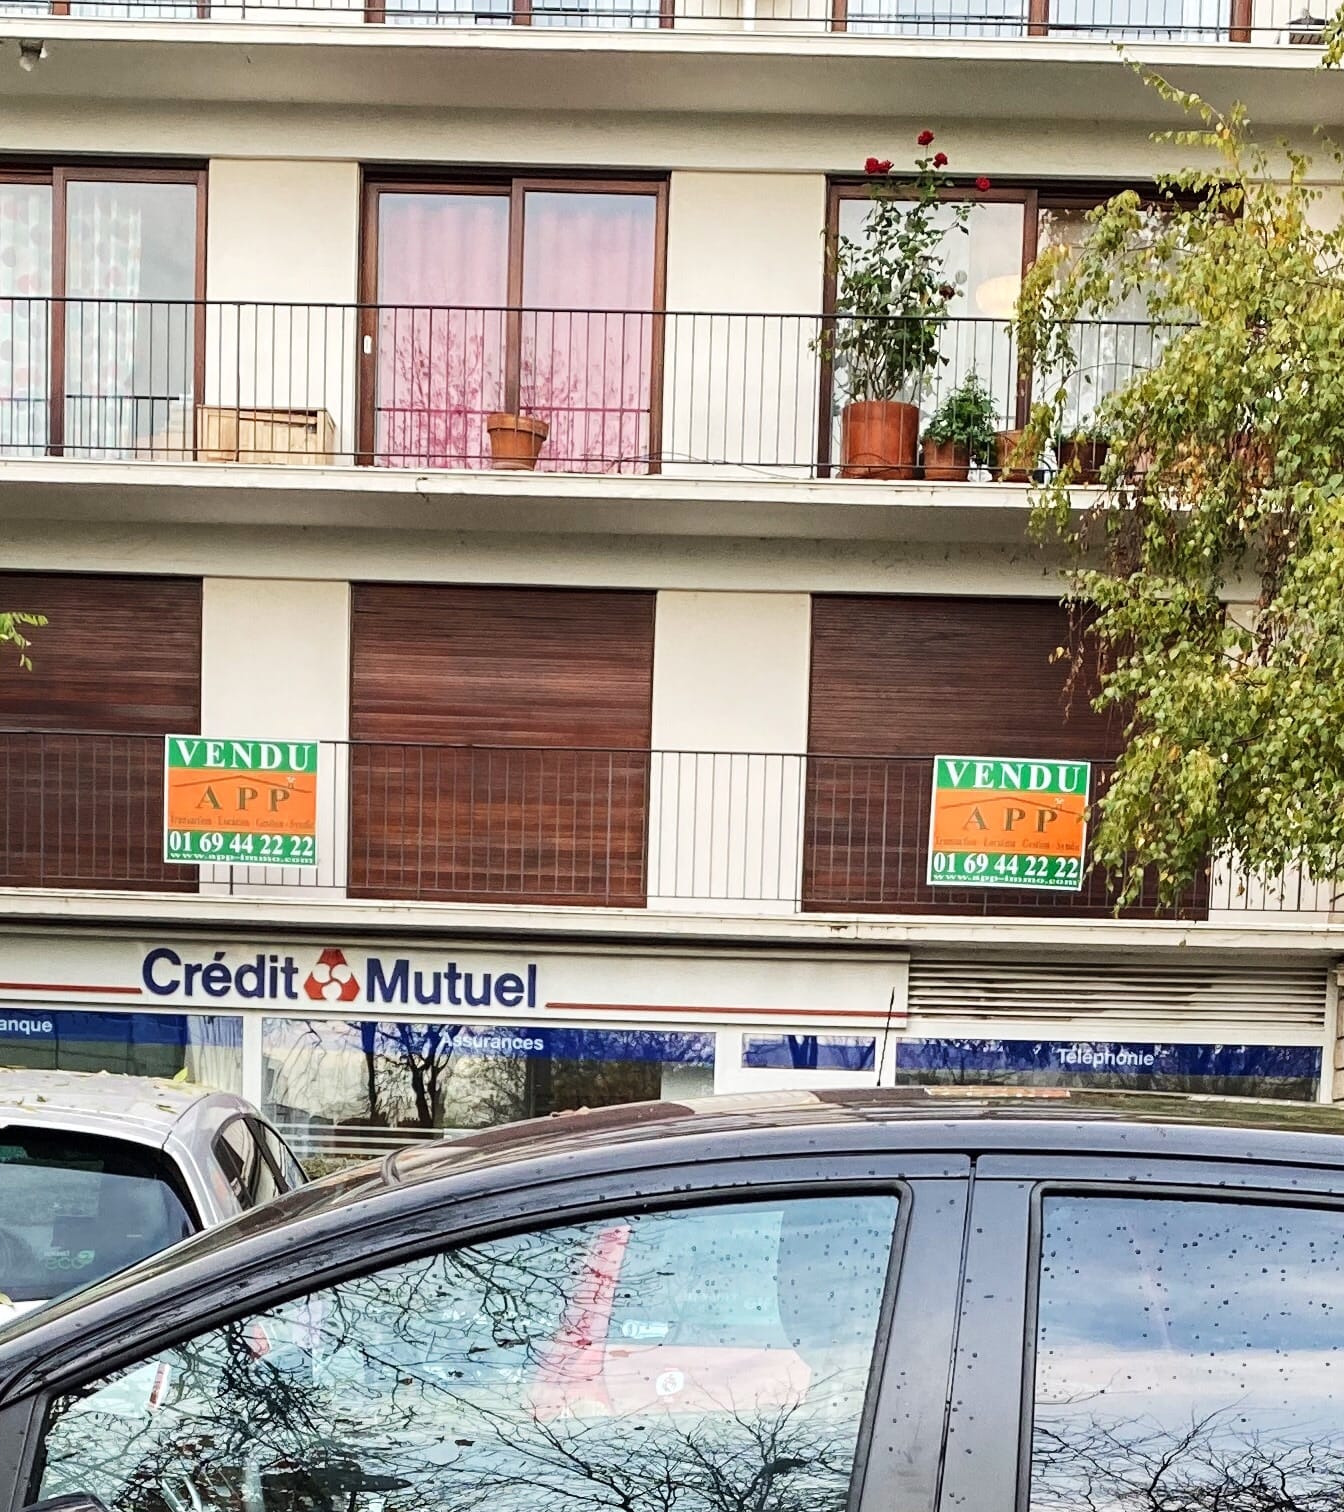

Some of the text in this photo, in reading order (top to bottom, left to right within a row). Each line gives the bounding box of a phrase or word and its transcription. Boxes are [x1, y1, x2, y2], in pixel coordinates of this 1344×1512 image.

[175, 739, 311, 771] VENDU
[944, 761, 1081, 793] VENDU
[195, 785, 291, 812] APP
[962, 806, 1058, 833] APP
[169, 830, 314, 857] 01 69 44 22 22
[169, 851, 314, 864] www.app-immo.com
[933, 851, 1079, 879] 01 69 44 22 22
[933, 873, 1079, 887] www.app-immo.com
[142, 947, 537, 1008] Crédit Mutuel
[440, 1030, 544, 1051] Assurances
[1056, 1048, 1155, 1069] Téléphonie
